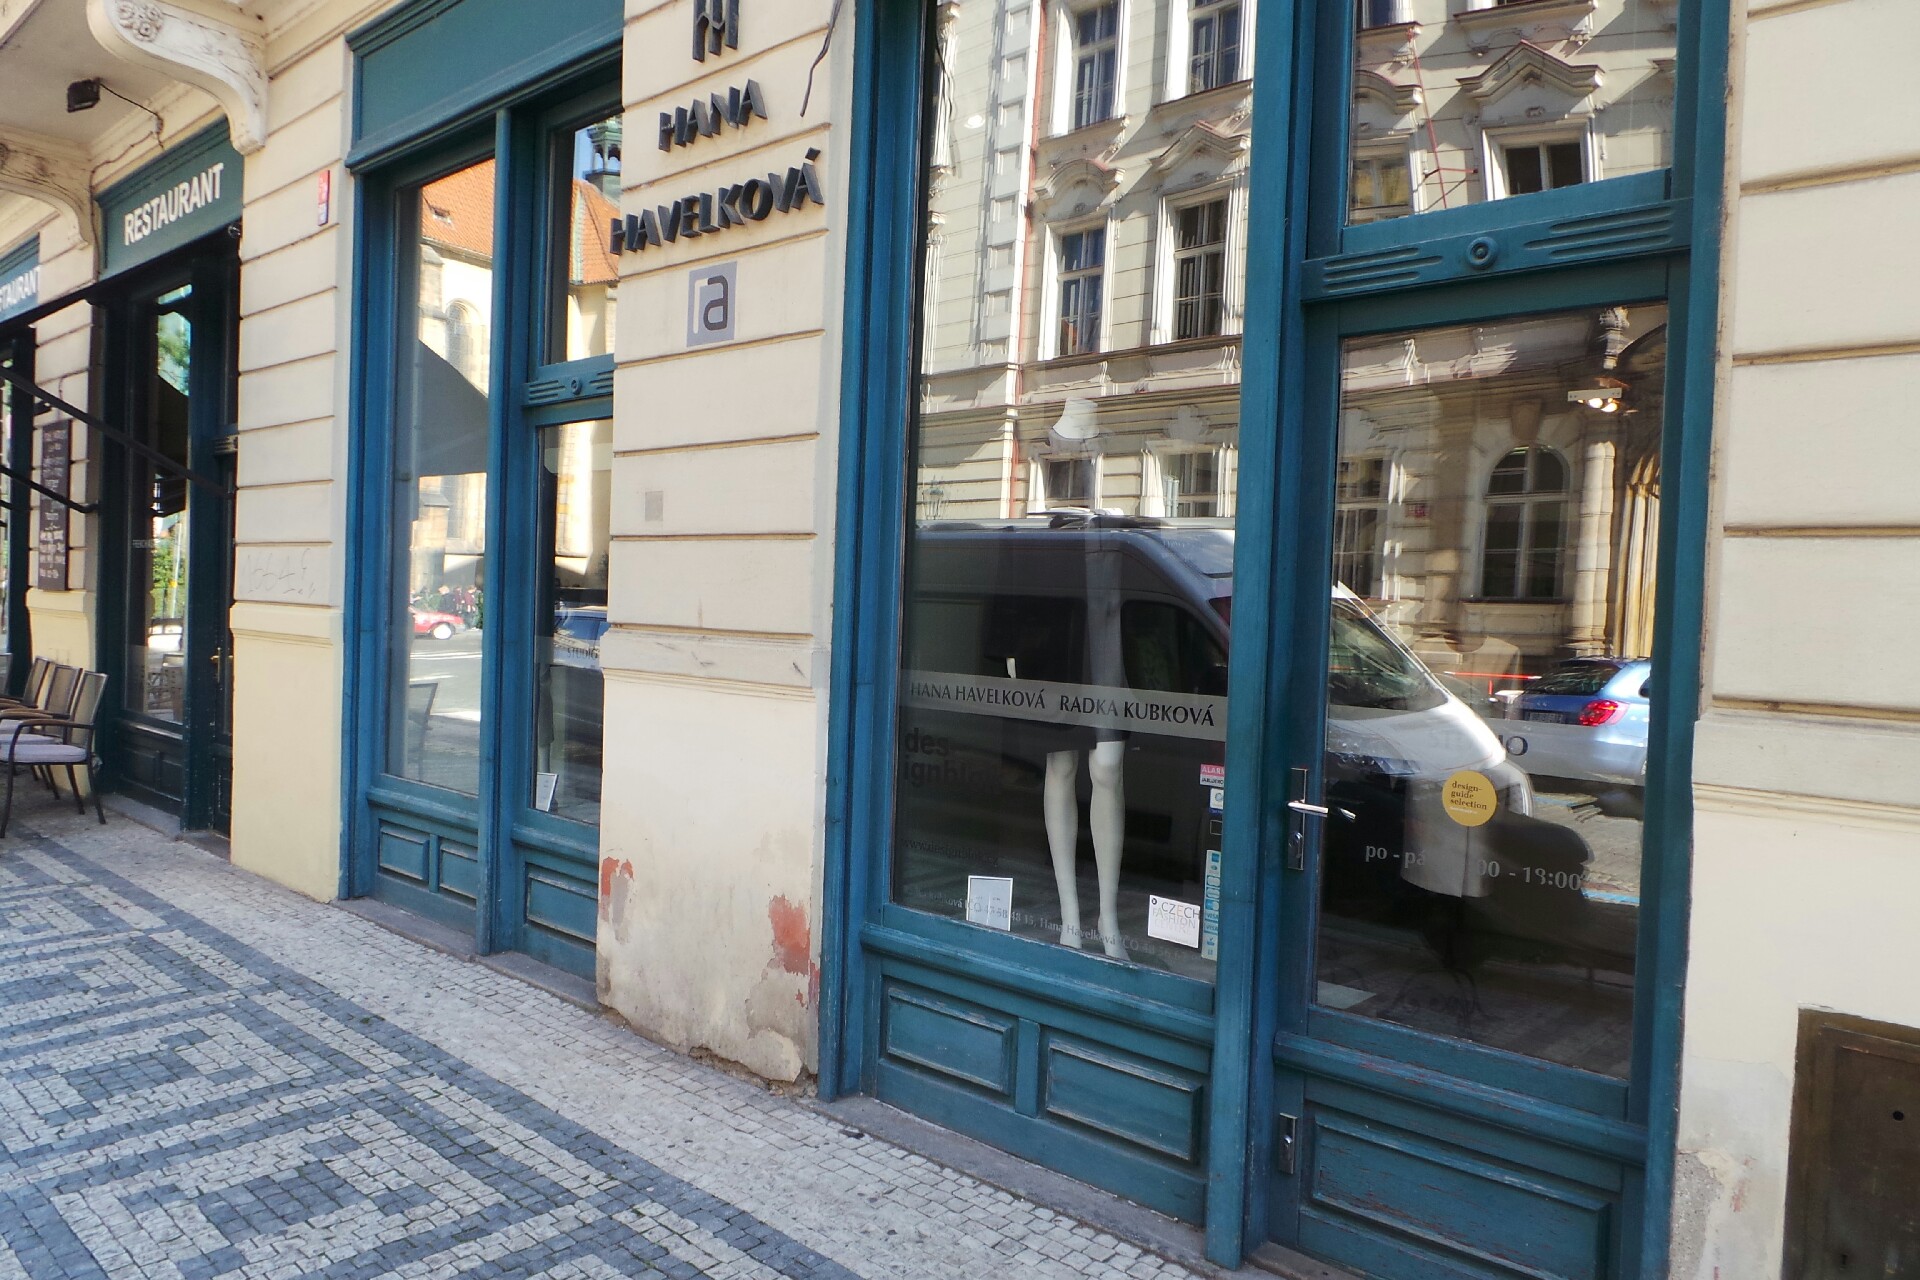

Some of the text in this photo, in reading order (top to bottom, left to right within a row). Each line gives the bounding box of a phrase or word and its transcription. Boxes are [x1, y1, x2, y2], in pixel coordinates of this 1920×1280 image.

[658, 78, 768, 152] HANA
[123, 162, 224, 246] RESTAURANT
[610, 147, 825, 256] HAVELKOVÁ
[911, 682, 1215, 726] HANA HAVELKOVÁ RADKA KUBKOVÁ
[904, 727, 949, 757] des
[1450, 798, 1487, 810] selection
[1451, 789, 1474, 799] guide
[1365, 845, 1387, 862] po
[1152, 907, 1196, 929] FASHION
[1161, 901, 1200, 919] CZECH
[1040, 917, 1063, 933] Hana
[1066, 924, 1116, 945] Havelková
